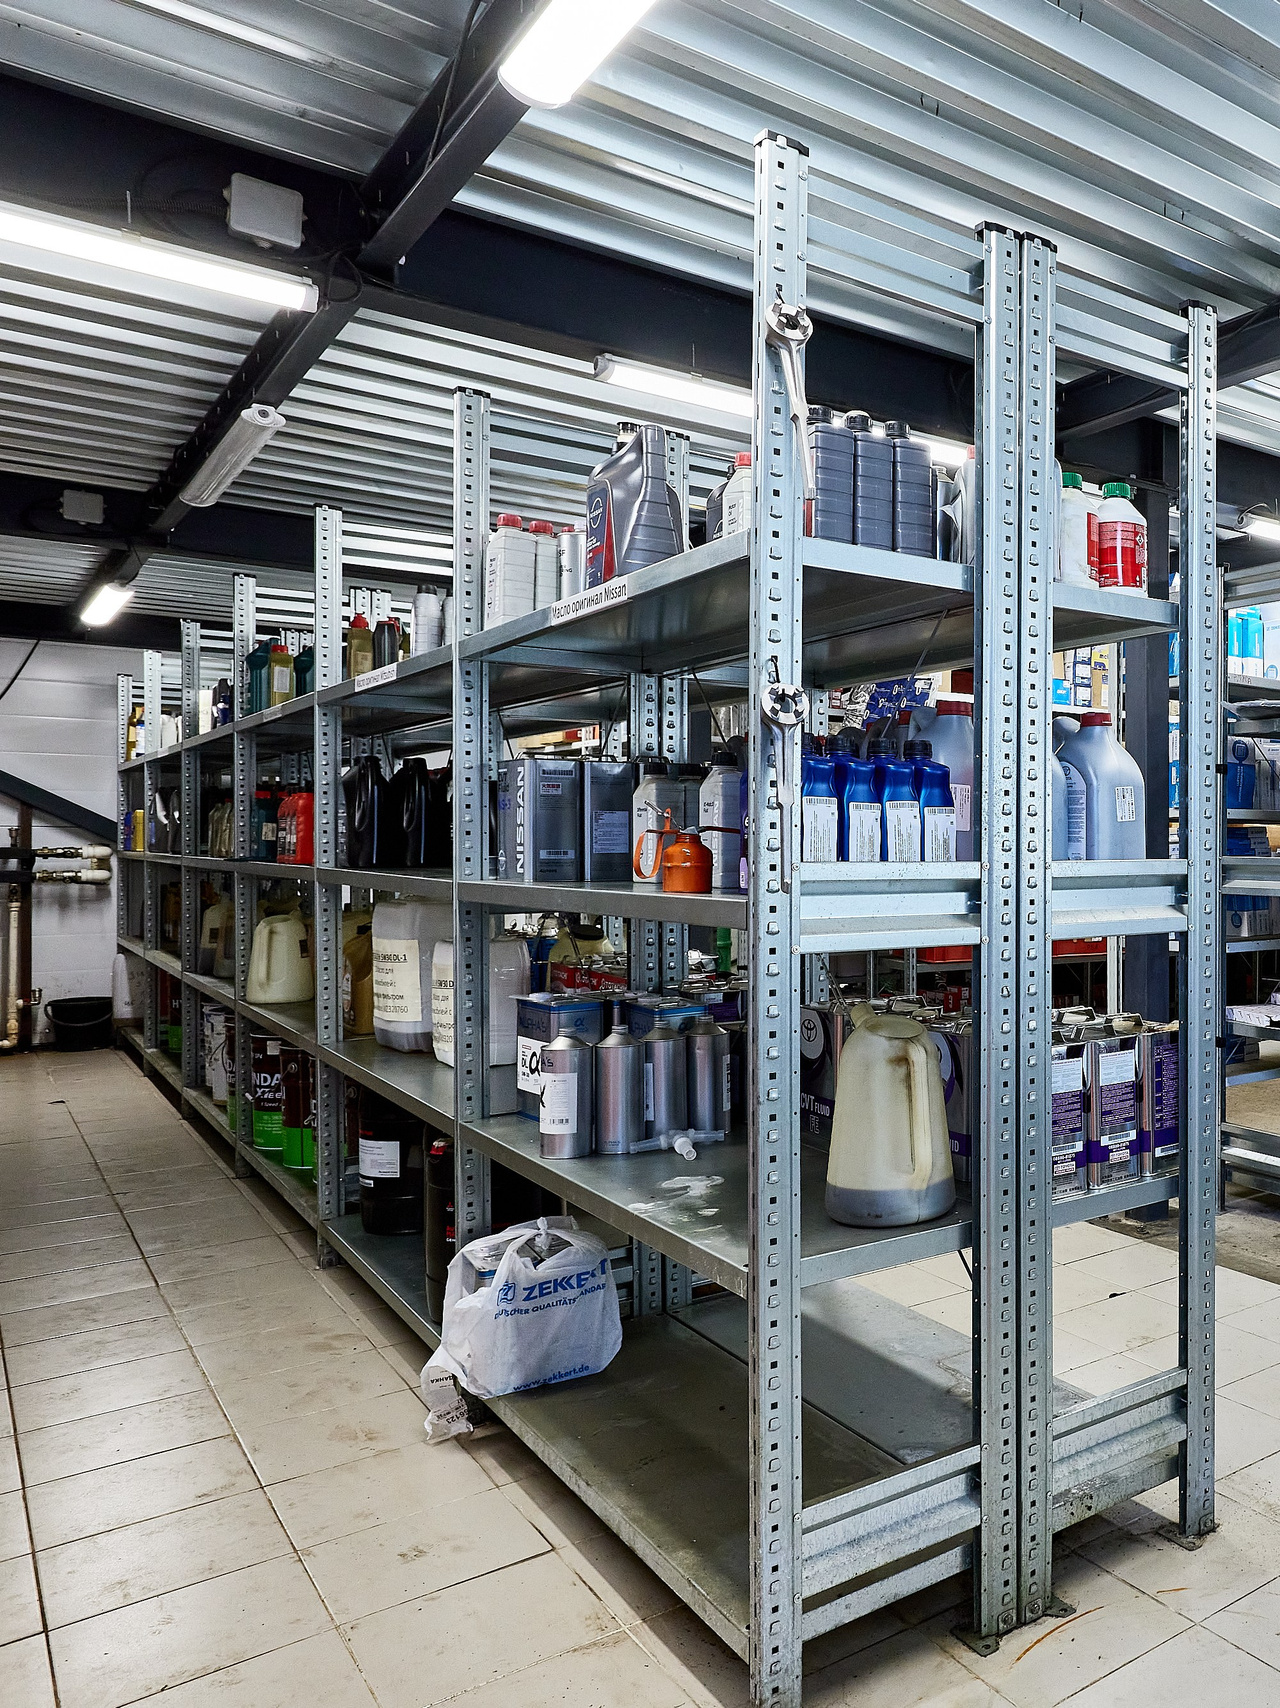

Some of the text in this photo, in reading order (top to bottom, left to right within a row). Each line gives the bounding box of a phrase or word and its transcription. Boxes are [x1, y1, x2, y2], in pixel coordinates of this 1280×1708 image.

[552, 583, 627, 619] Масло оригинал Nissan
[516, 766, 524, 874] NISSAN
[800, 1092, 832, 1117] CVT FLUID
[513, 1364, 590, 1391] www.zekkert.de
